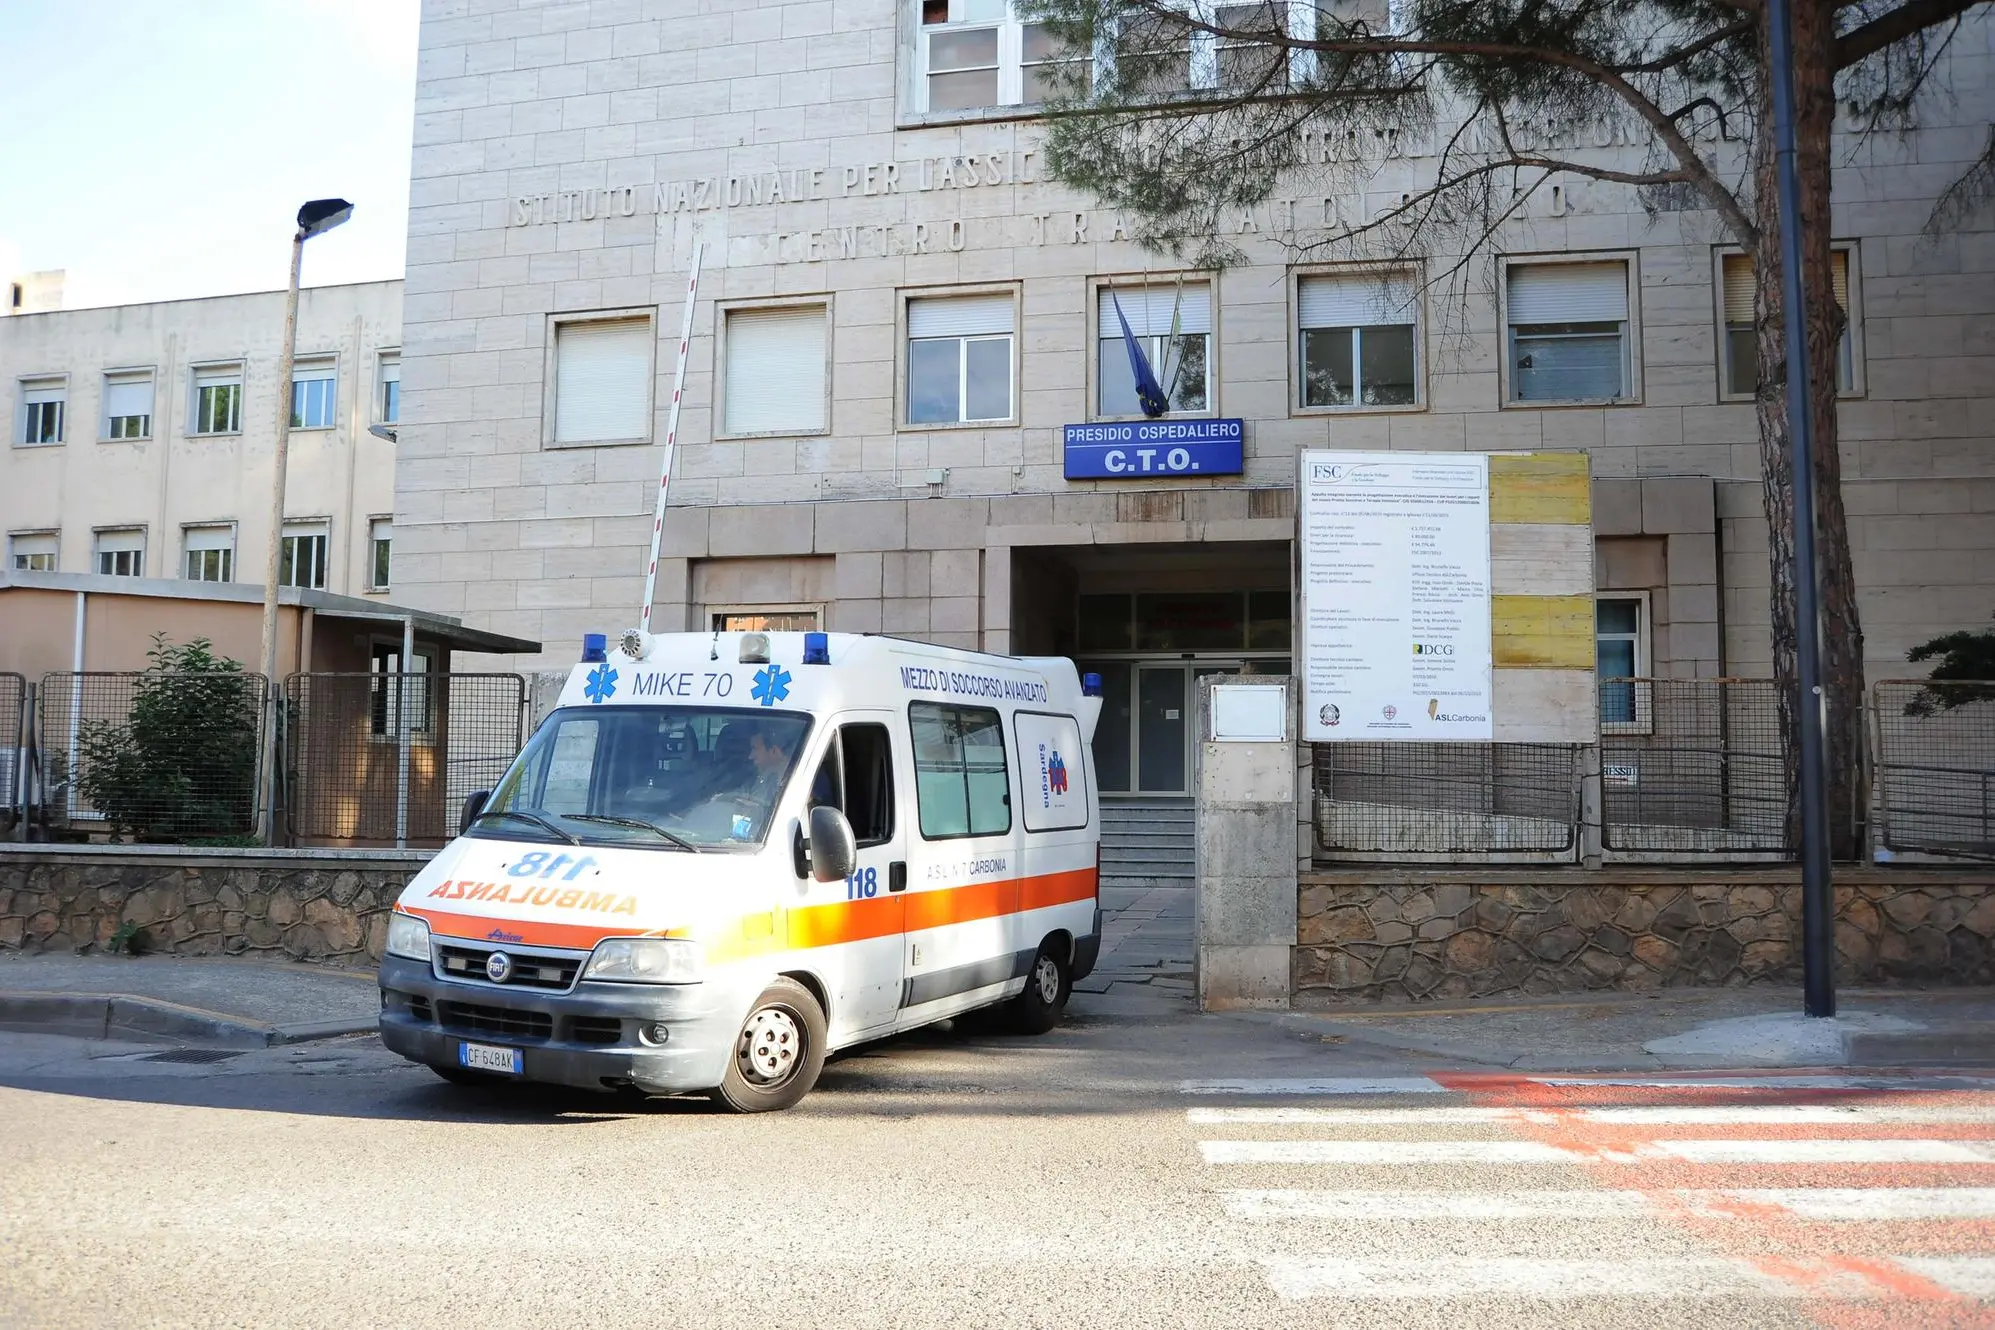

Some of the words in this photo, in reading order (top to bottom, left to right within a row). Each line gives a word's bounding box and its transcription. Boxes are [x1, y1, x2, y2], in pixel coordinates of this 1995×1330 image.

[653, 167, 823, 213] NAZIONALE
[842, 160, 898, 197] PER
[776, 218, 964, 265] CENTRO
[1067, 427, 1132, 442] PRESIDIO
[1139, 423, 1240, 440] OSPEDALIERO
[1104, 448, 1200, 472] C.T.O.
[1313, 465, 1342, 479] FSC
[1423, 644, 1453, 655] DCG
[632, 673, 694, 696] MIKE
[703, 673, 733, 697] 70
[900, 666, 938, 691] MEZZO
[939, 670, 950, 692] DI
[951, 672, 1003, 698] SOCCORSO
[1004, 680, 1047, 703] AVANZATO
[1435, 714, 1486, 723] ASLCarbonia
[1039, 743, 1050, 808] Sardegna
[969, 857, 1008, 876] CARBONIA
[844, 867, 877, 900] 118
[489, 962, 504, 974] FIAT
[468, 1048, 480, 1064] CF
[483, 1050, 513, 1069] 648AK
